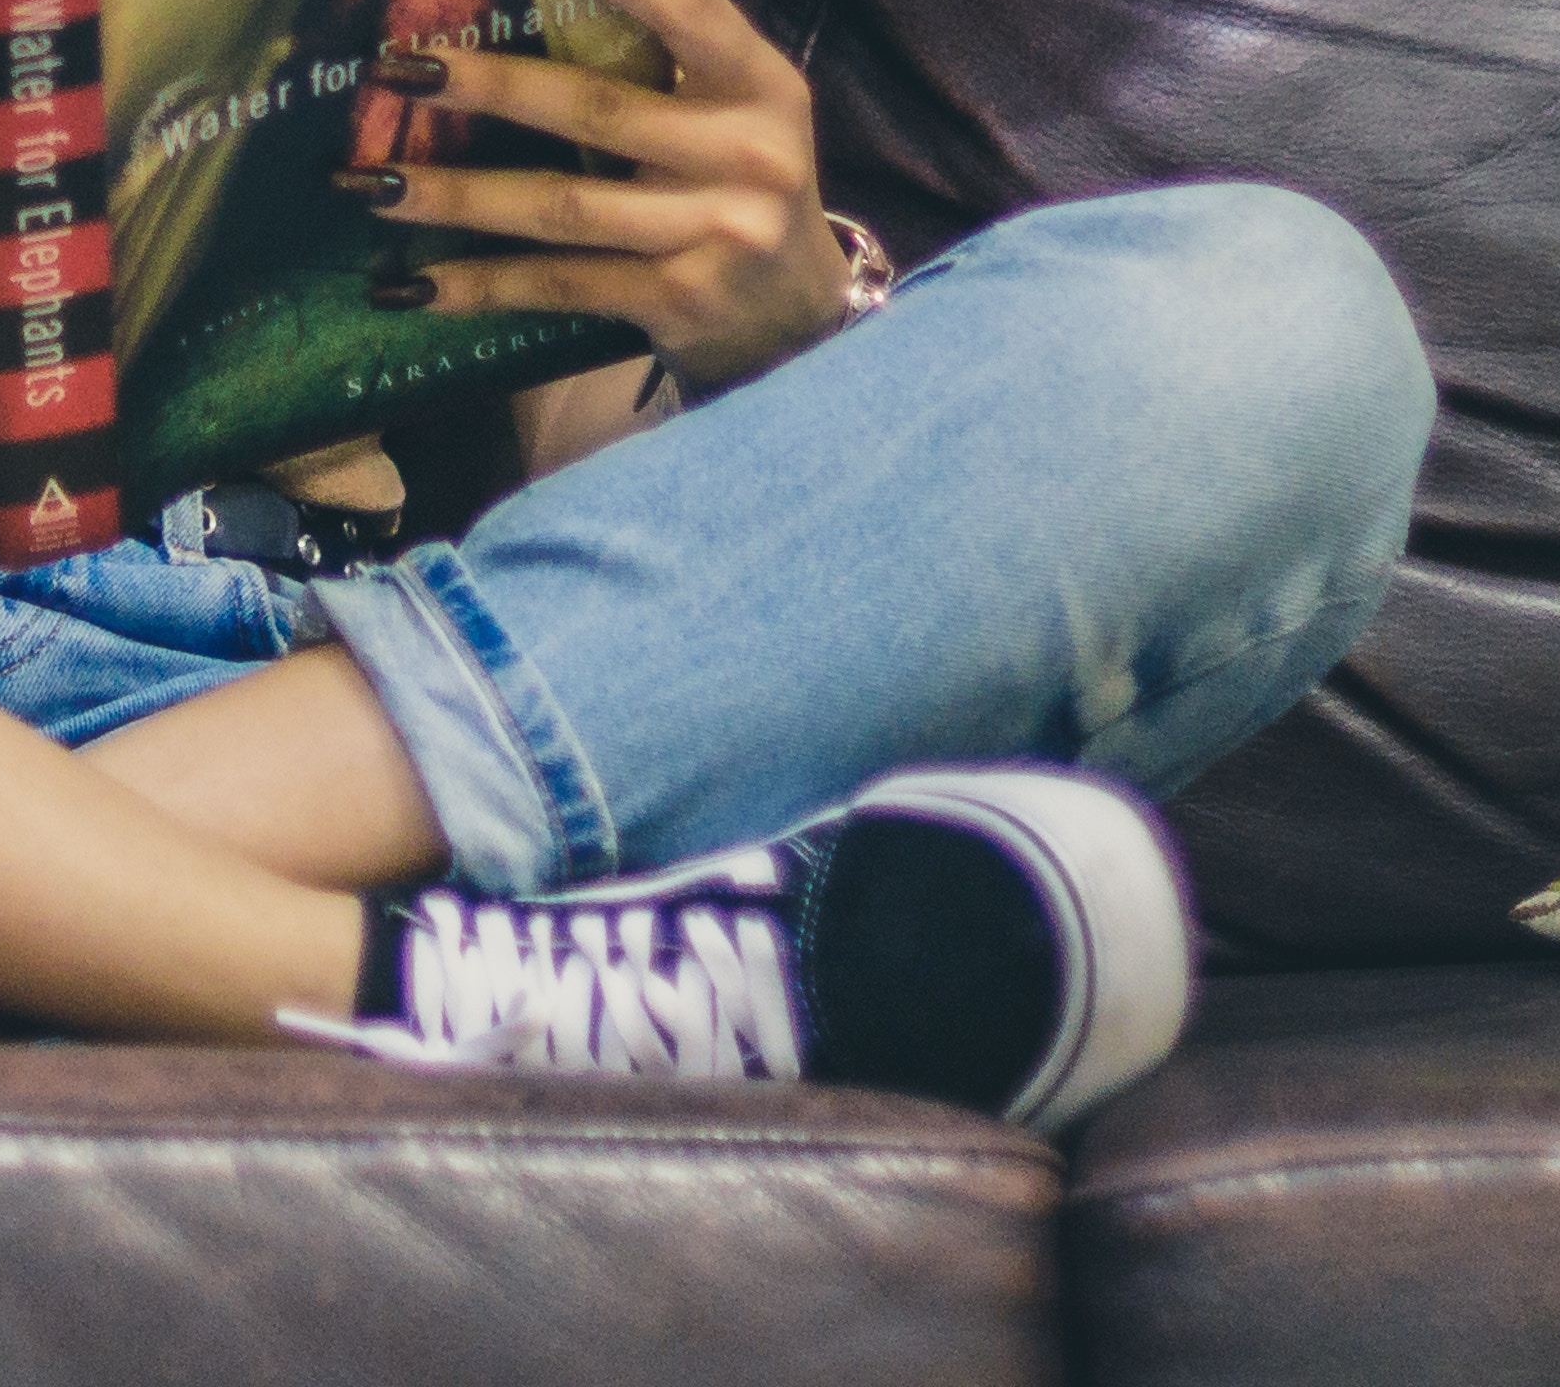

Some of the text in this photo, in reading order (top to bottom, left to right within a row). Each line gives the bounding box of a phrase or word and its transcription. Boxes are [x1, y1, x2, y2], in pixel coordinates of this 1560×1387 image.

[160, 76, 295, 159] Water
[310, 56, 365, 98] for
[14, 126, 70, 189] for
[10, 200, 74, 409] Elephants
[345, 317, 602, 400] SARA GRUE
